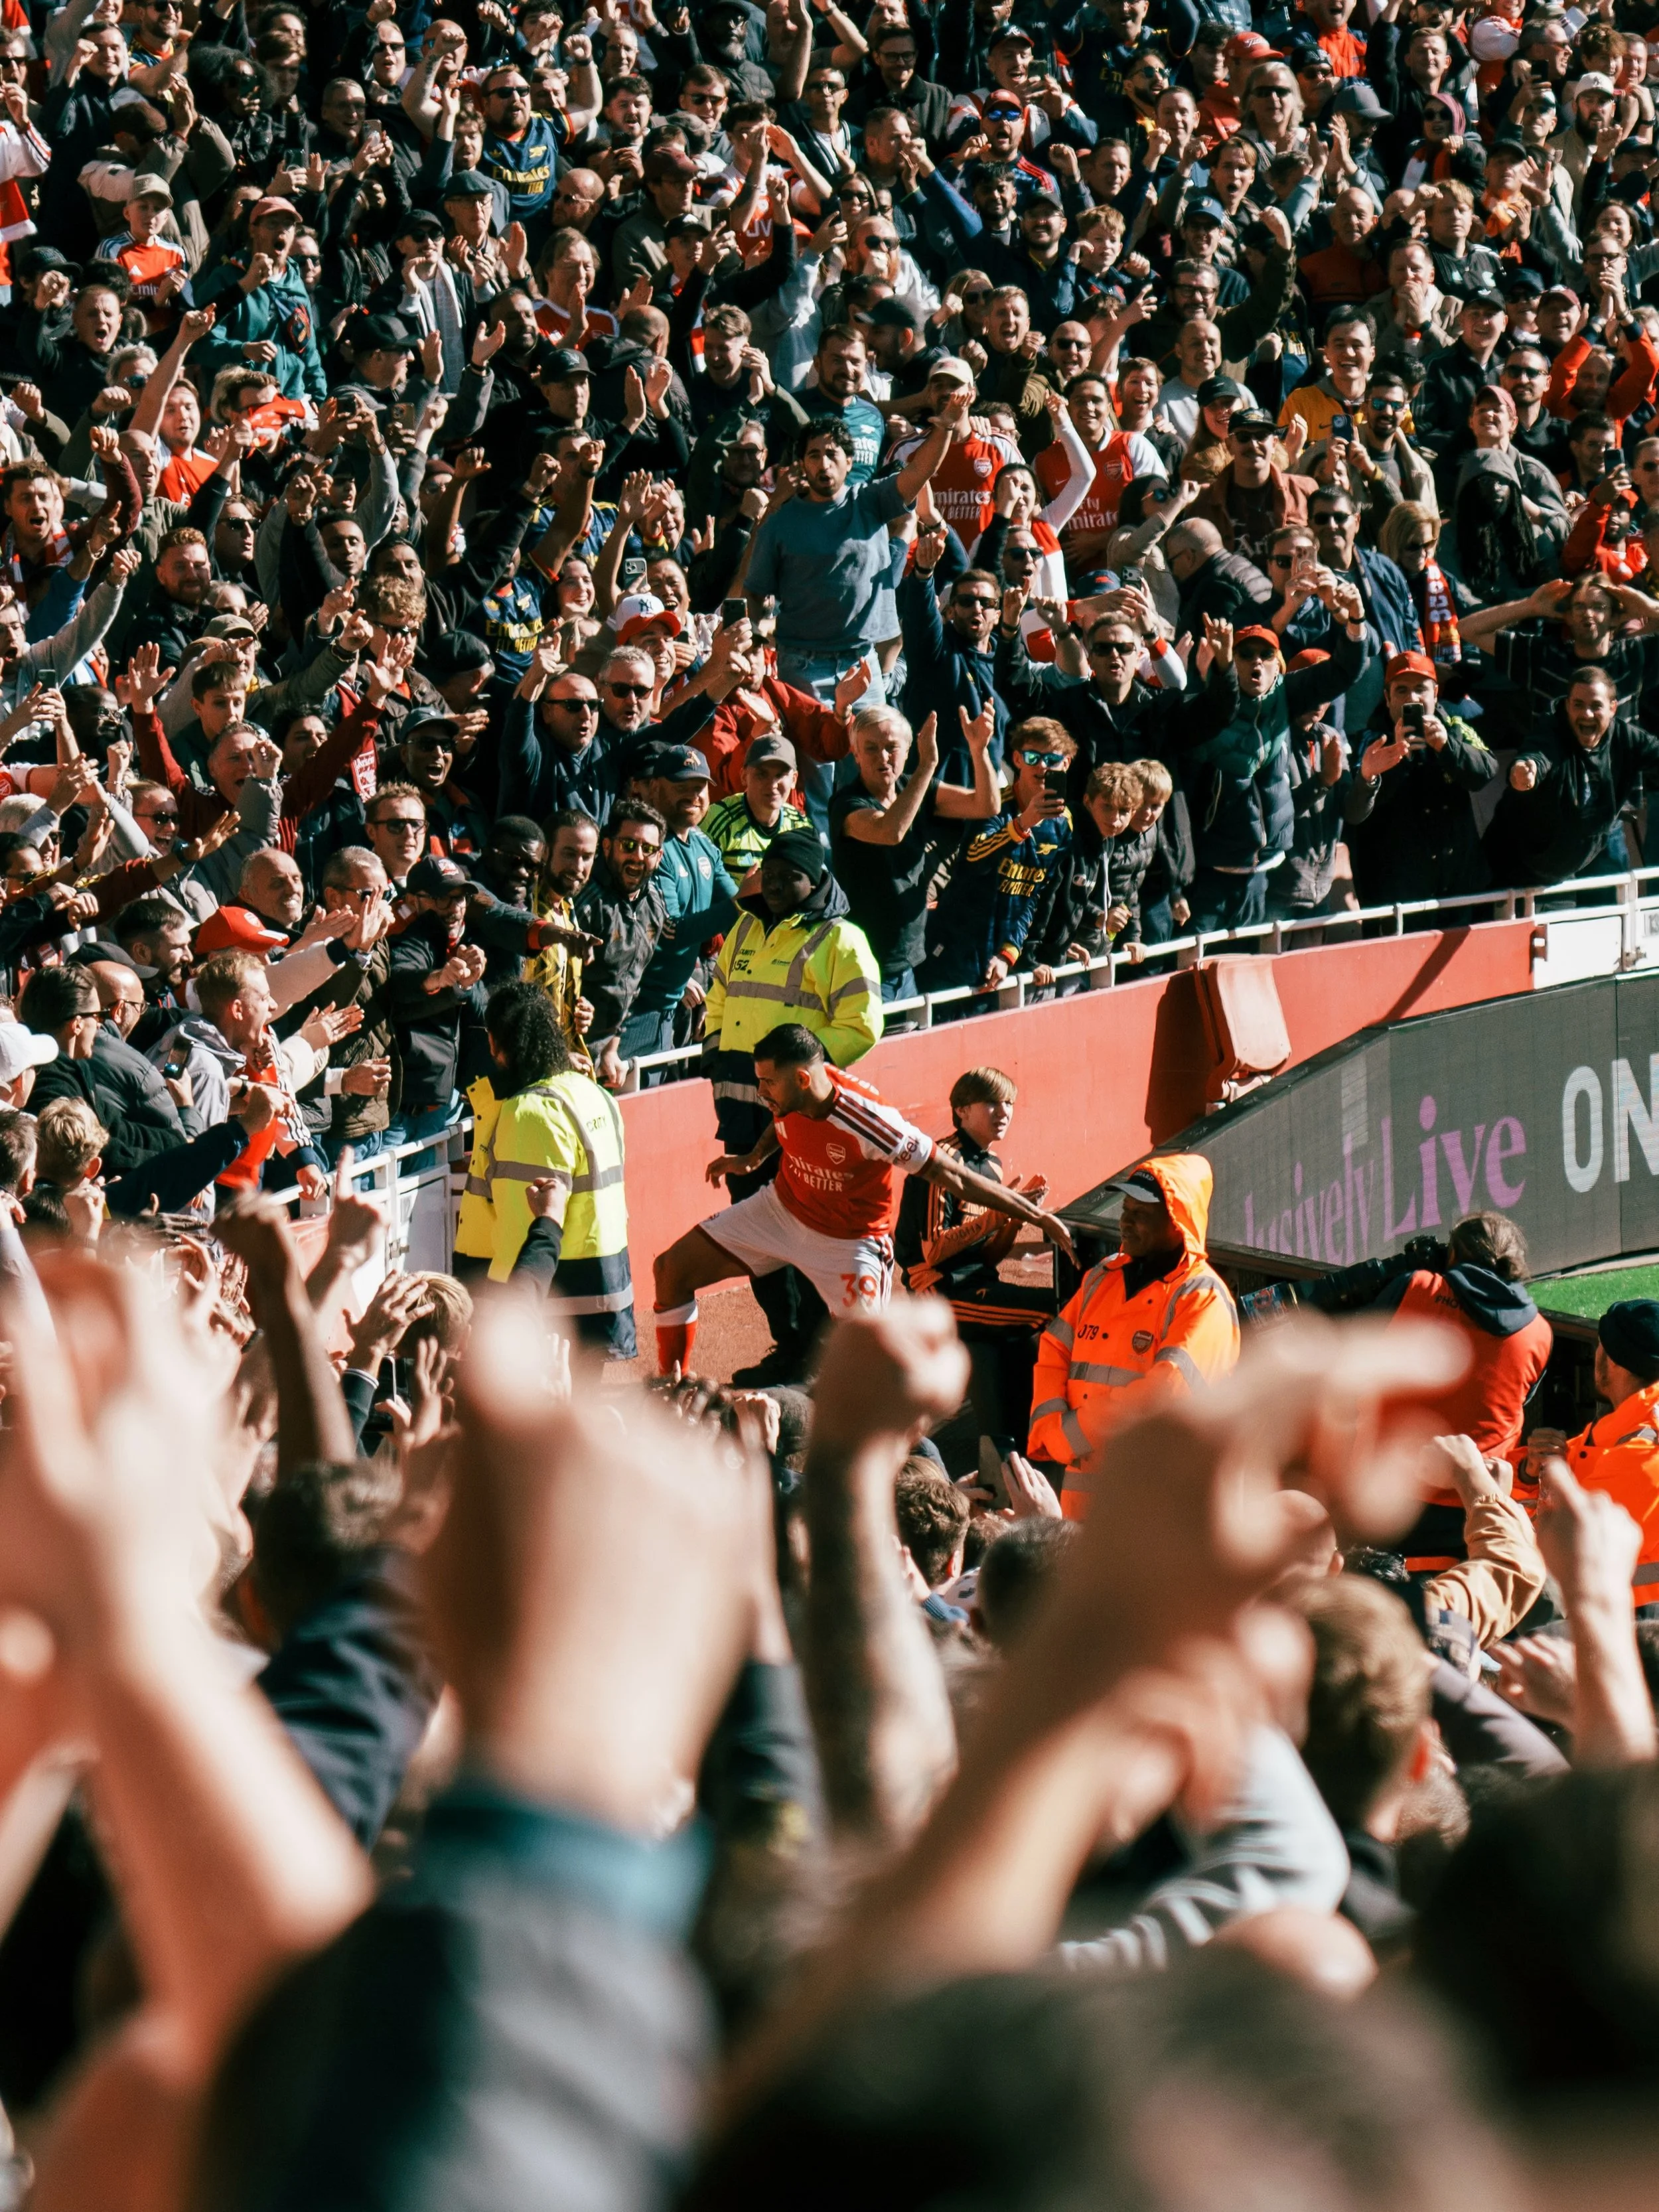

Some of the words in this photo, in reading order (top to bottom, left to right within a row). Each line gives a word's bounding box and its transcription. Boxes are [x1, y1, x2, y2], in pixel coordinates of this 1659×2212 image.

[948, 505, 982, 520] BETTER
[803, 1171, 843, 1193] BETTER
[1238, 1133, 1376, 1266] lusively
[1382, 1095, 1528, 1240] Live
[840, 1272, 878, 1309] 39
